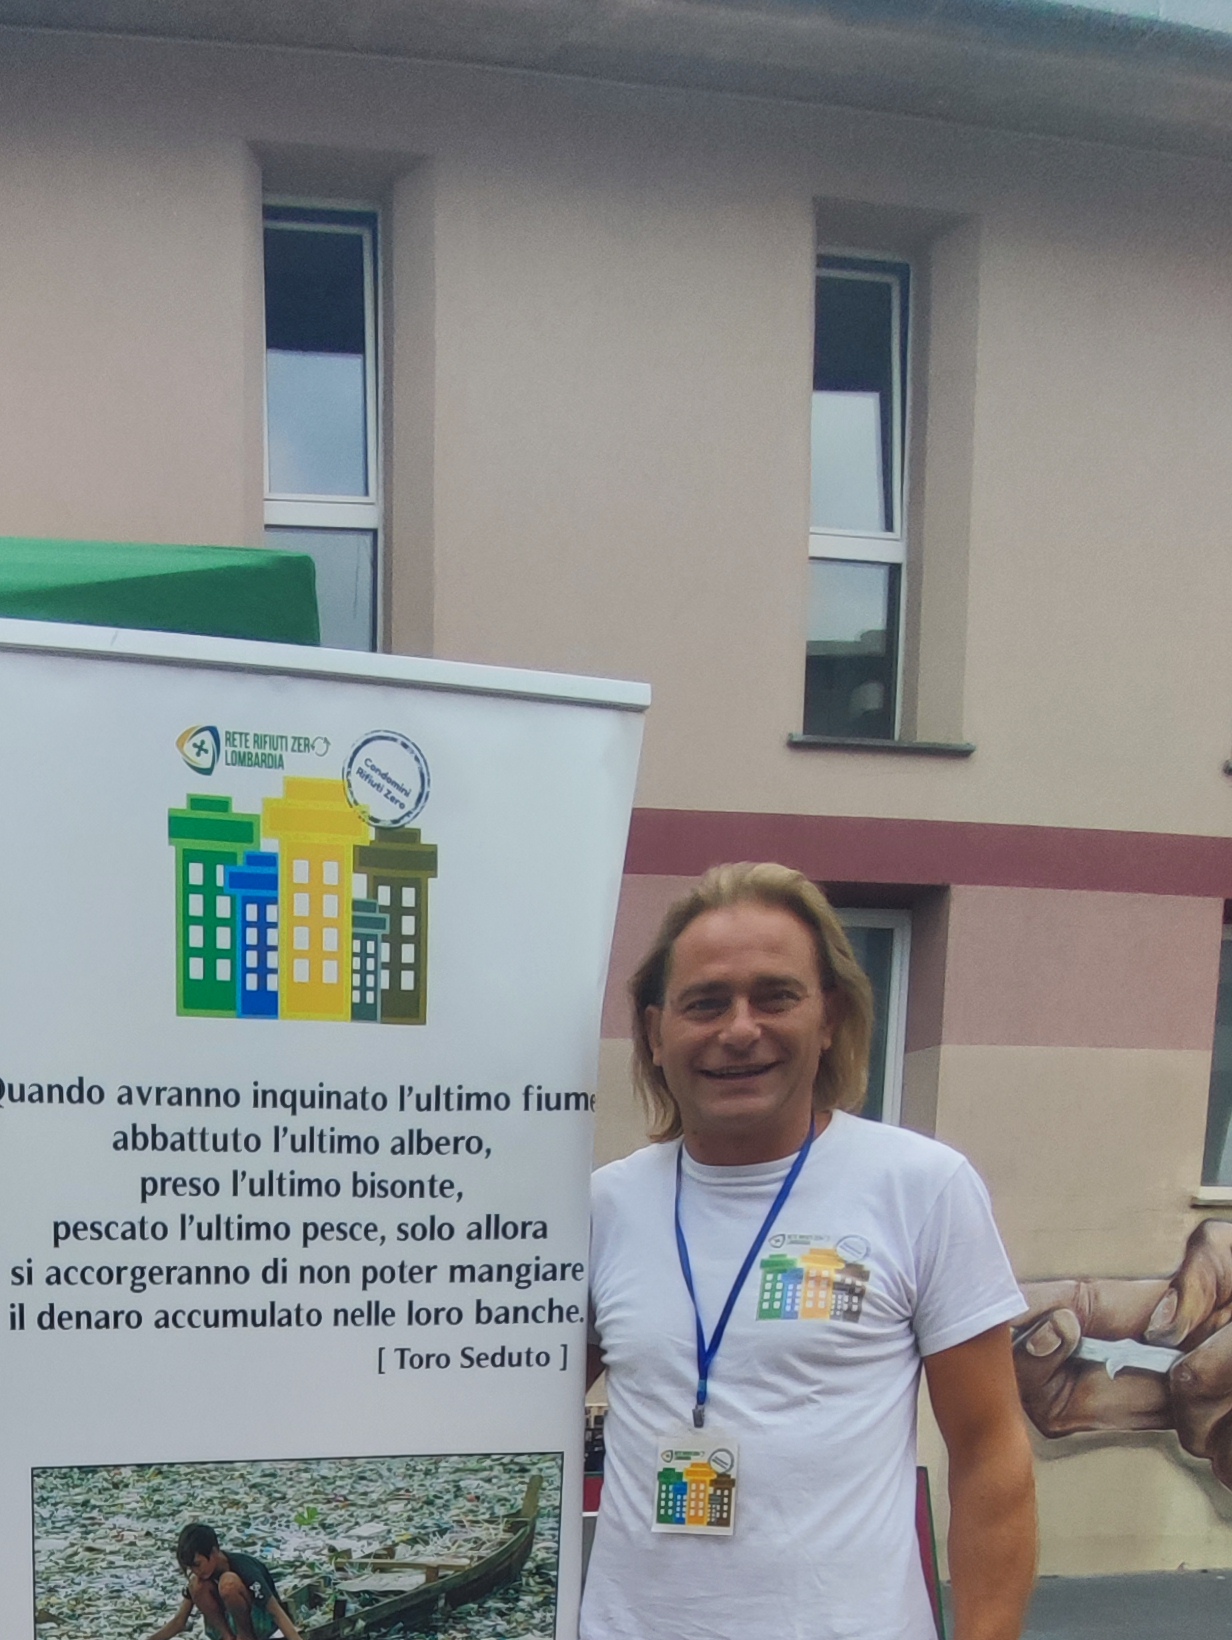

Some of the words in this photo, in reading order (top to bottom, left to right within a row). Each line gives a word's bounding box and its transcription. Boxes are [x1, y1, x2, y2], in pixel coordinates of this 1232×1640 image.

[225, 731, 250, 749] RETE
[253, 733, 288, 752] RIFIUTI
[225, 750, 284, 770] LOMBARDIA
[364, 757, 412, 797] Condomini
[356, 766, 384, 793] Rifiuti
[383, 788, 406, 810] Zero
[117, 1085, 240, 1108] avranno
[253, 1081, 387, 1116] inquinato
[399, 1085, 510, 1112] l'ultimo
[113, 1123, 261, 1152] abbattuto
[274, 1125, 379, 1155] l'ultimo
[391, 1128, 491, 1159] albero,
[141, 1177, 220, 1203] preso
[233, 1169, 341, 1197] l'ultimo
[352, 1171, 463, 1202] bisonte,
[53, 1216, 168, 1248] pescato
[180, 1213, 290, 1241] l'ultimo
[303, 1222, 385, 1248] pesce,
[397, 1215, 455, 1241] solo
[467, 1214, 547, 1240] allora
[11, 1258, 32, 1286] si
[45, 1266, 250, 1293] accorgeranno
[262, 1258, 287, 1284] di
[300, 1265, 350, 1284] non
[362, 1260, 438, 1291] poter
[449, 1256, 584, 1289] mangiare
[10, 1303, 25, 1330] il
[37, 1303, 142, 1330] denaro
[154, 1301, 322, 1329] accumulato
[333, 1300, 395, 1326] nelle
[408, 1300, 463, 1326] loro
[476, 1297, 584, 1324] banche.
[394, 1348, 450, 1369] Toro
[460, 1345, 550, 1368] Seduto
